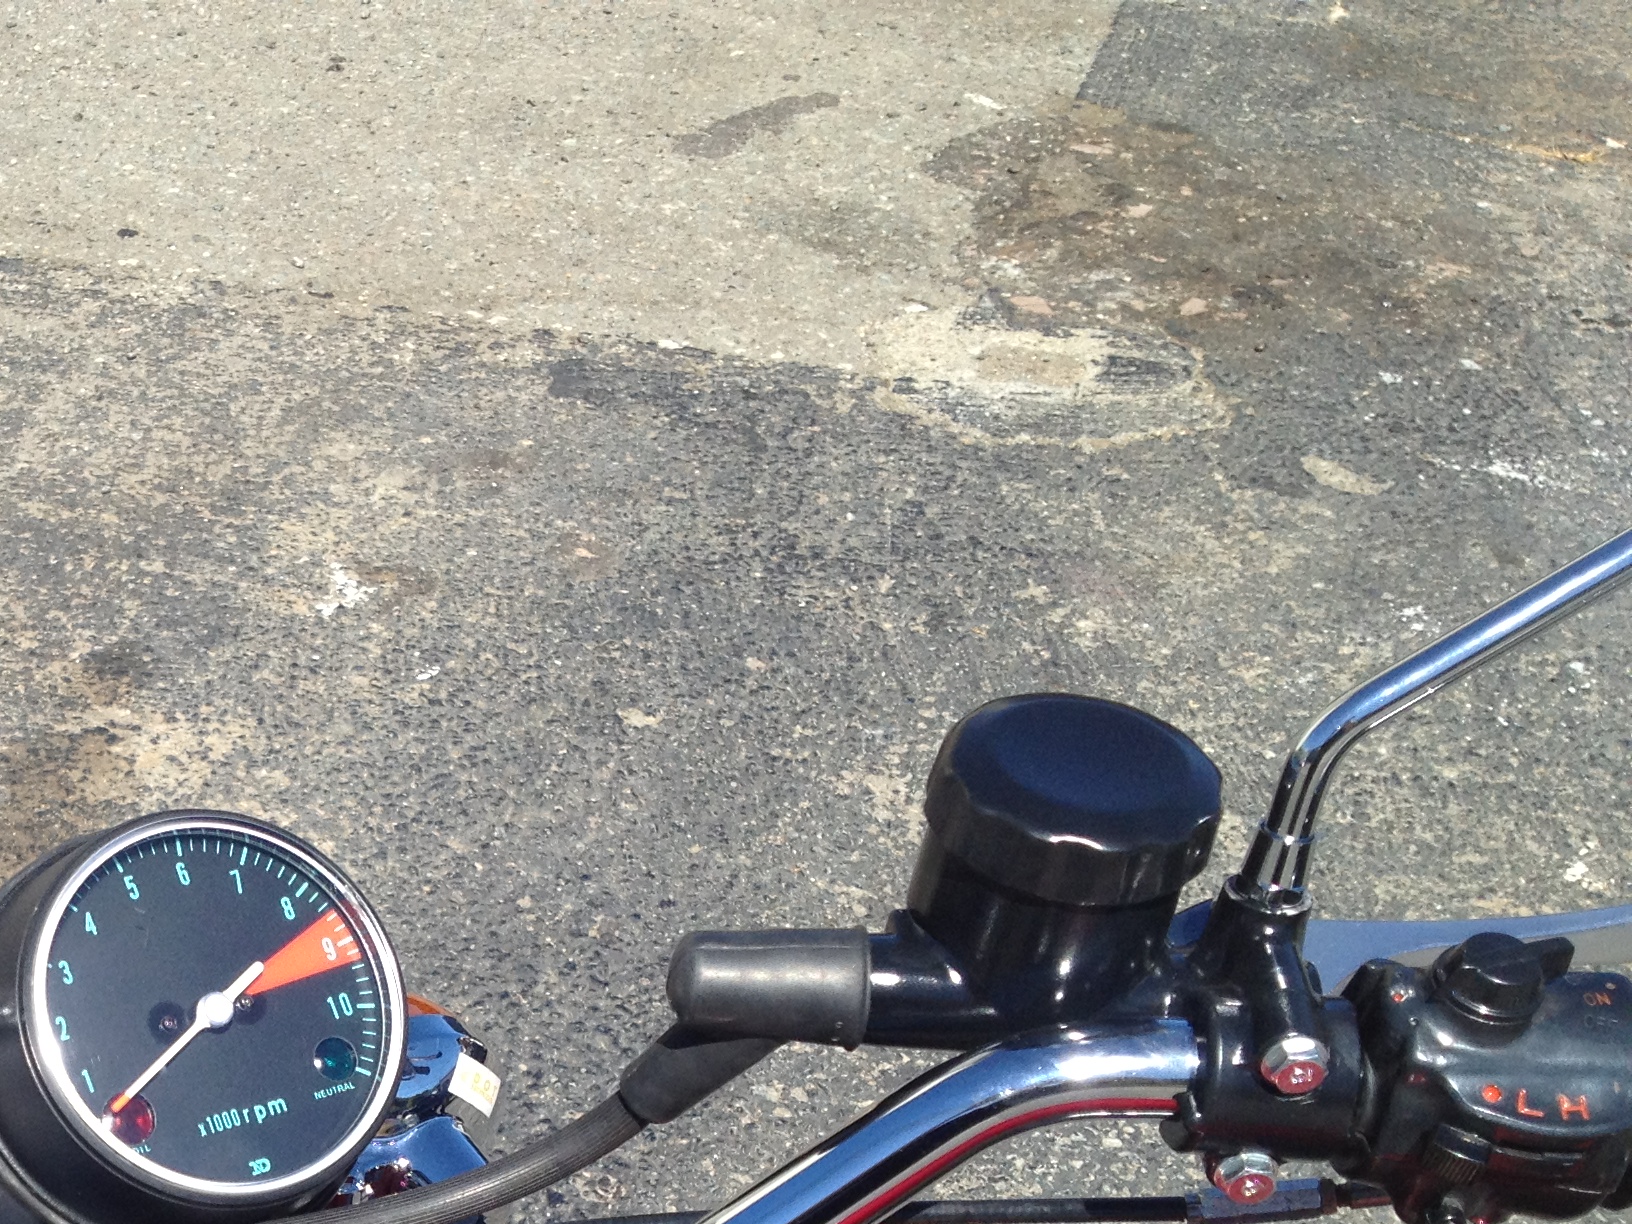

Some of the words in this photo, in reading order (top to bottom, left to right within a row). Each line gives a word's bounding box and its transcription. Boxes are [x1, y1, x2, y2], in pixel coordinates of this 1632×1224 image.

[175, 862, 192, 886] 6
[229, 869, 243, 894] 7
[124, 876, 140, 900] 5
[280, 897, 296, 920] 8
[84, 912, 98, 935] 4
[321, 936, 337, 961] 9
[58, 960, 74, 985] 3
[327, 993, 353, 1019] 10
[1583, 991, 1612, 1006] ON
[55, 1017, 71, 1041] 2
[82, 1070, 96, 1093] 1
[314, 1082, 356, 1100] NEUTRAL
[244, 1098, 288, 1124] rpm
